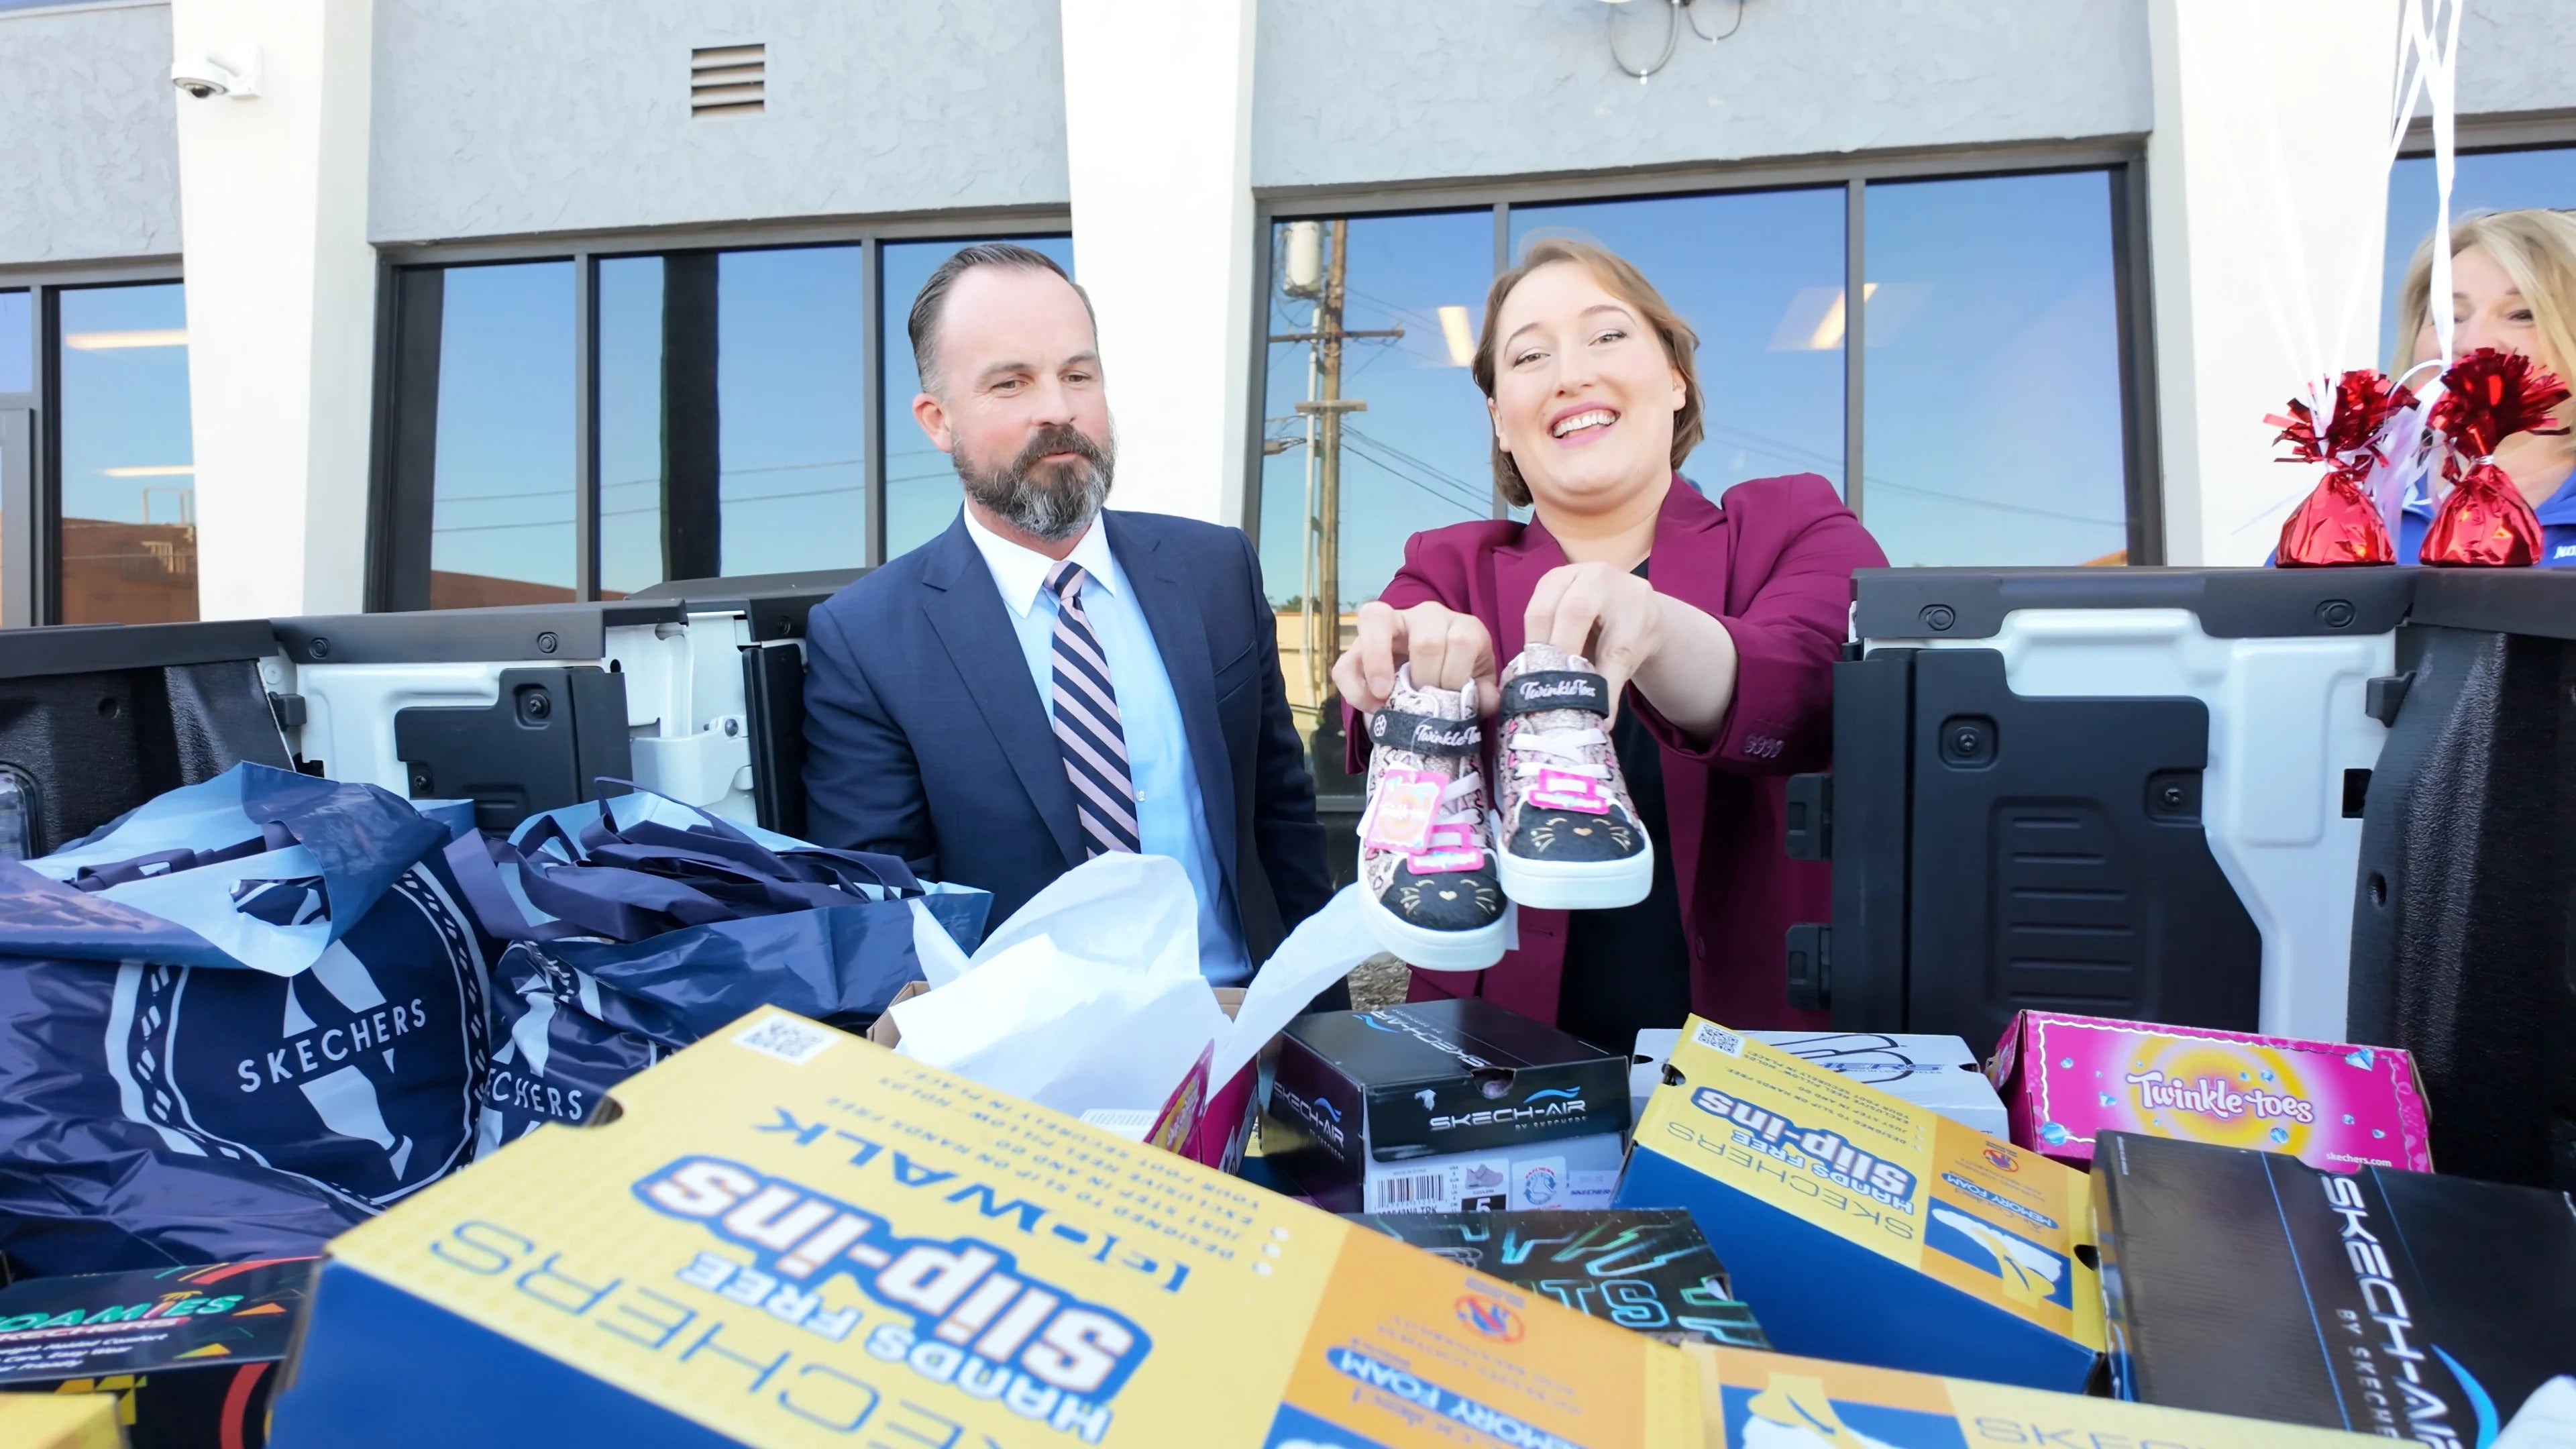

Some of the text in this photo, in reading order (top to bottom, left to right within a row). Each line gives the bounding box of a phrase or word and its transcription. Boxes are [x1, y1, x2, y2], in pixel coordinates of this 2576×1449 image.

[237, 998, 427, 1093] SKECHERS
[1743, 1053, 1776, 1070] HOLDS
[488, 1068, 583, 1120] ECHERS
[1756, 1079, 1792, 1096] HANDS
[1799, 1071, 1851, 1095] SECURELY
[1825, 1087, 1851, 1099] HEEL
[1794, 1094, 1809, 1104] ON
[1811, 1102, 1835, 1115] SLIP
[1814, 1093, 1835, 1104] AND
[1839, 1102, 1851, 1110] IN
[1853, 1093, 1880, 1107] FOOT
[2125, 1070, 2314, 1124] Twinkle toes
[1274, 1080, 1344, 1149] SKECH-AIR
[1430, 1099, 1587, 1132] SKECH-AIR
[1837, 1112, 1851, 1122] TO
[1852, 1109, 1879, 1122] STEP
[1853, 1097, 1909, 1124] EXCLUSIVE
[1882, 1106, 1910, 1120] YOUR
[1853, 1120, 1907, 1144] DESIGNED
[1882, 1122, 1907, 1134] JUST
[975, 1151, 1012, 1171] ON
[1731, 1129, 1806, 1169] FREE
[2325, 1152, 2392, 1167] skechers.com
[1031, 1152, 1079, 1177] AND
[1014, 1167, 1069, 1194] SLIP
[1667, 1122, 1914, 1240] SKECHERS
[1811, 1163, 1915, 1216] HANDS
[1947, 1174, 1988, 1198] FOAM
[1991, 1193, 2053, 1228] MEMORY
[1112, 1203, 1236, 1262] DESIGNED
[0, 1290, 244, 1332] OAMIES
[430, 1220, 1004, 1449] ECHERS
[674, 1250, 1114, 1445] HANDS FREE
[1339, 1348, 1443, 1411] FOAM
[2335, 1307, 2400, 1439] BY SKECHE
